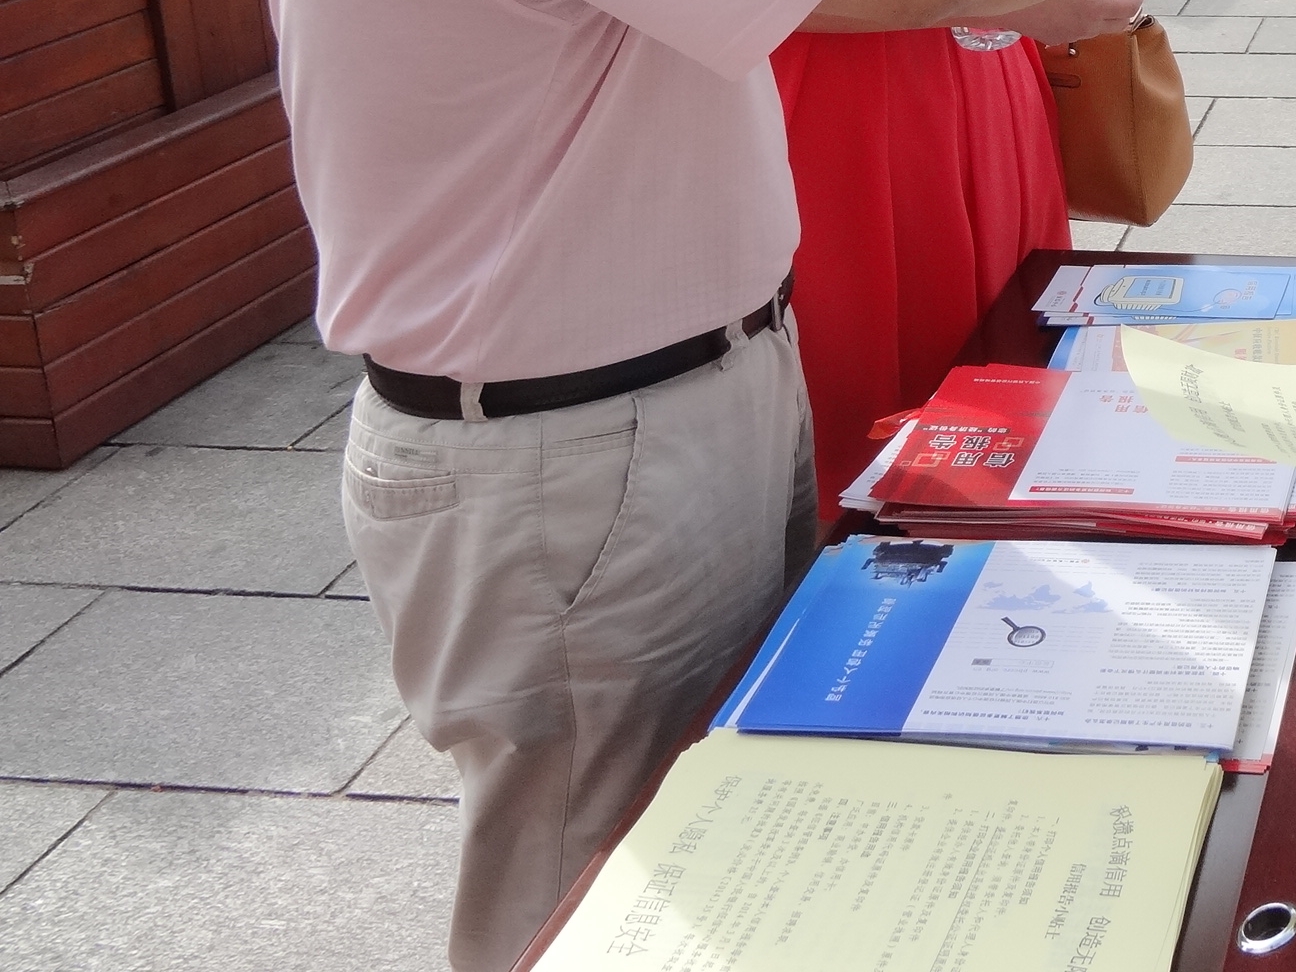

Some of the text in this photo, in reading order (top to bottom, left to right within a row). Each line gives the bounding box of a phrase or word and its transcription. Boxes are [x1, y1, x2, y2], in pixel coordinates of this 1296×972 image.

[1098, 394, 1135, 404] 报告
[1114, 403, 1149, 414] 信用
[928, 434, 992, 451] 报告
[951, 451, 1016, 469] 信用
[668, 774, 743, 854] 保护个人隐私
[606, 862, 687, 958] 保证信息安全
[1044, 862, 1088, 941] 信用报告小贴士
